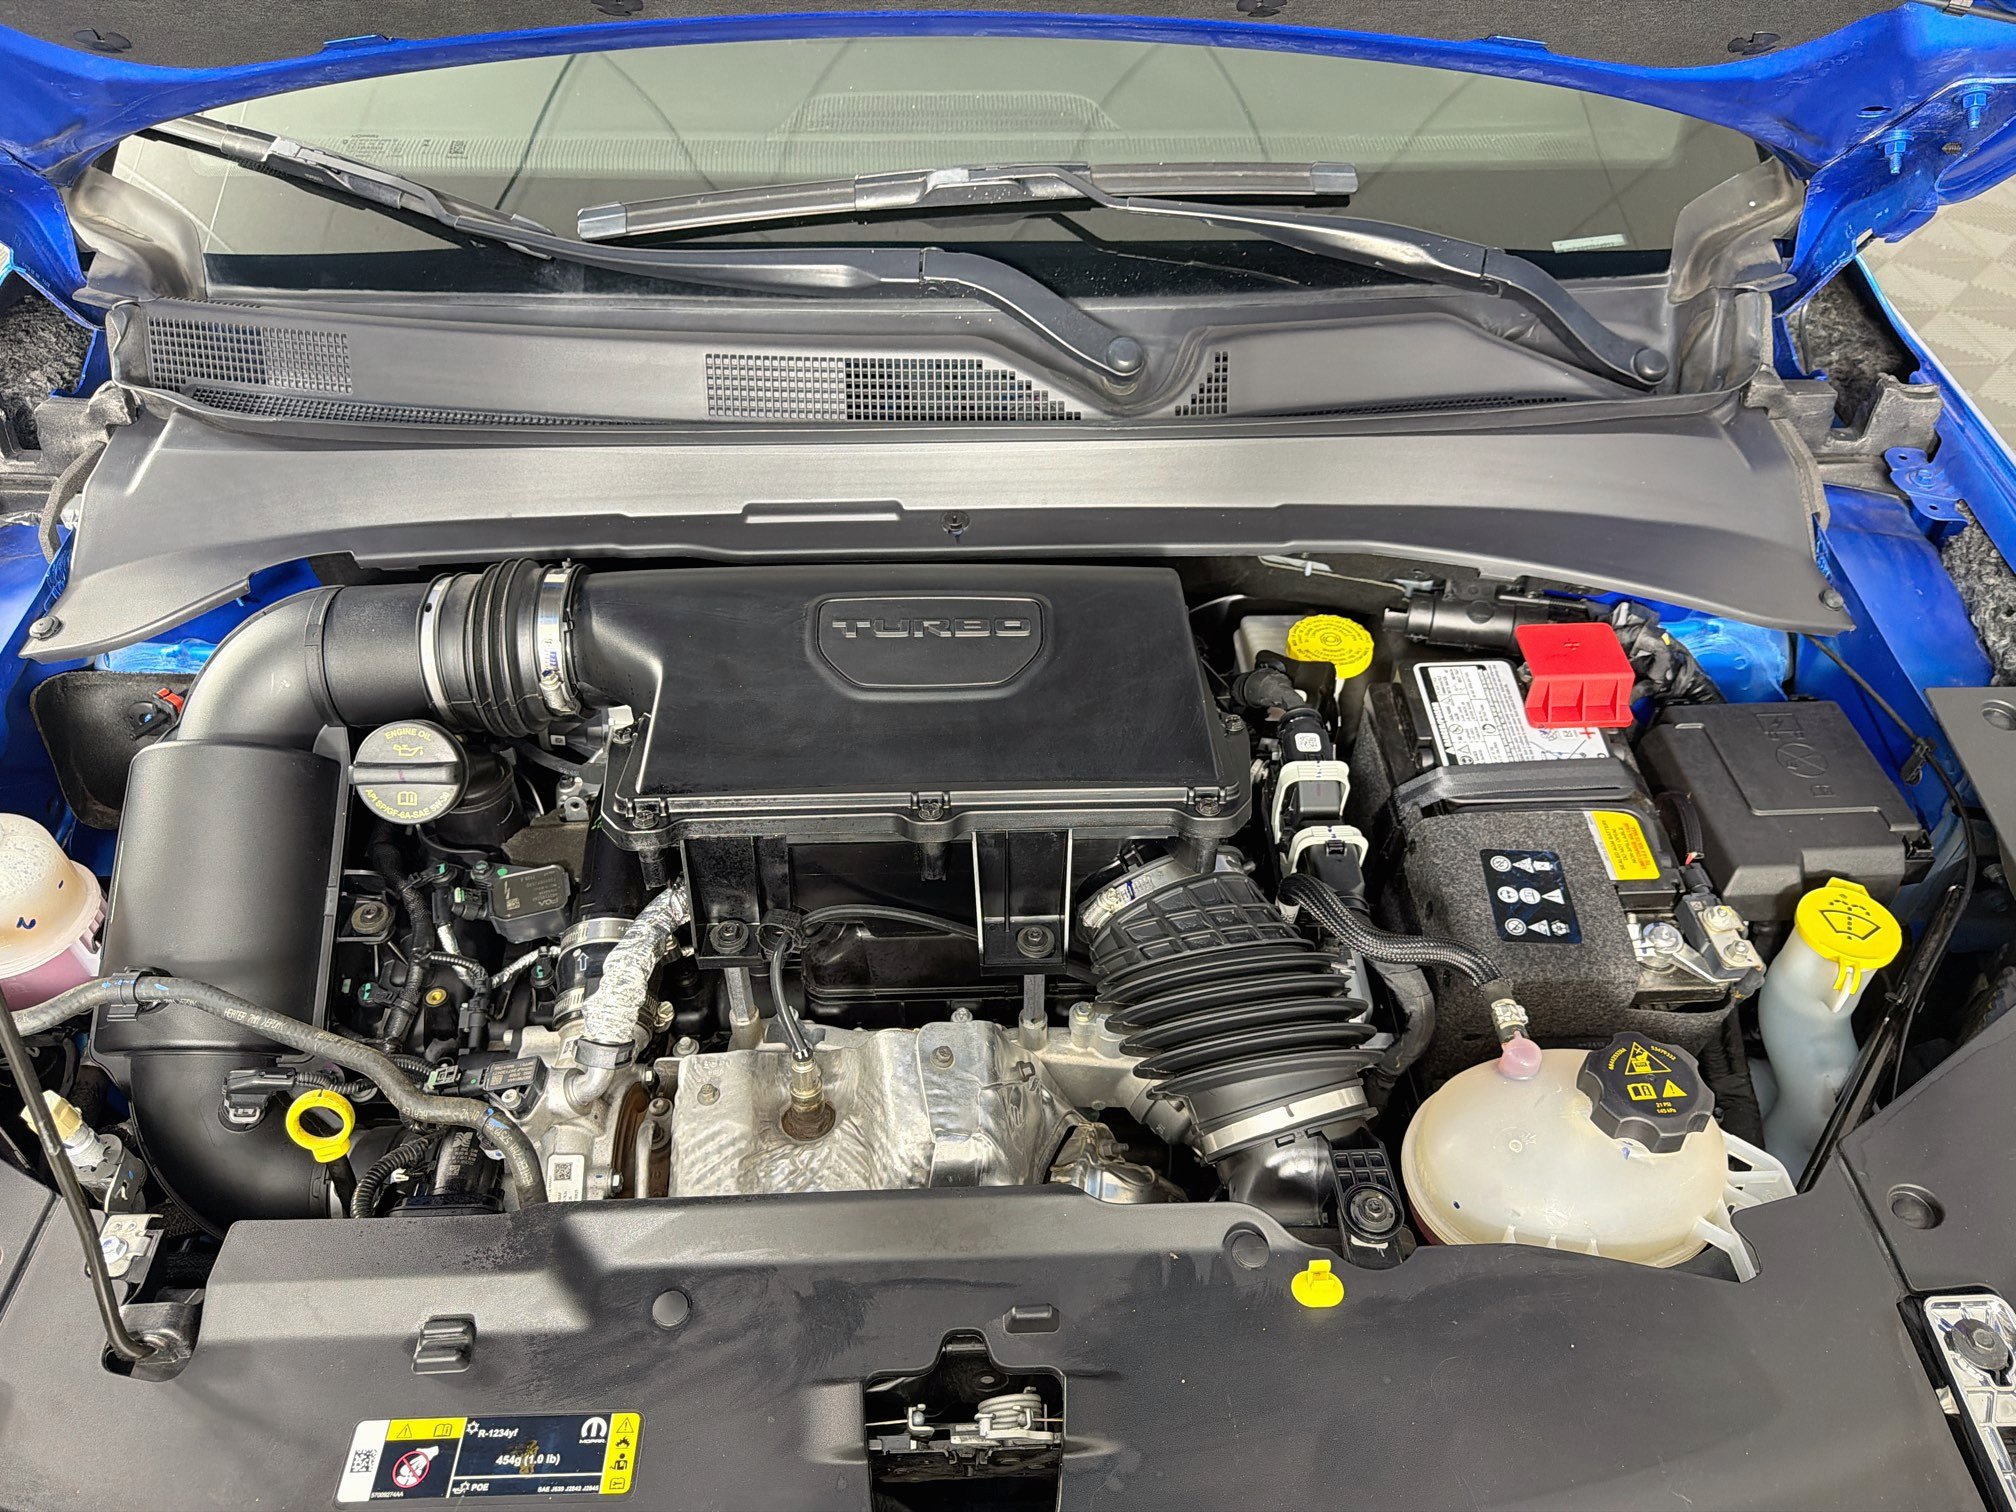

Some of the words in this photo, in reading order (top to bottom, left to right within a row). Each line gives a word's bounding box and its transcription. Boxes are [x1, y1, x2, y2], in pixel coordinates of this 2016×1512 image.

[832, 618, 1031, 638] TURBO
[384, 728, 417, 740] ENGINE
[418, 730, 432, 741] OIL
[366, 789, 376, 801] API
[224, 1008, 247, 1022] HEATER
[478, 1428, 518, 1439] R-1234yf
[496, 1454, 522, 1466] 454g
[524, 1454, 545, 1466] (1.0
[546, 1454, 560, 1466] lb)
[471, 1482, 489, 1492] POE
